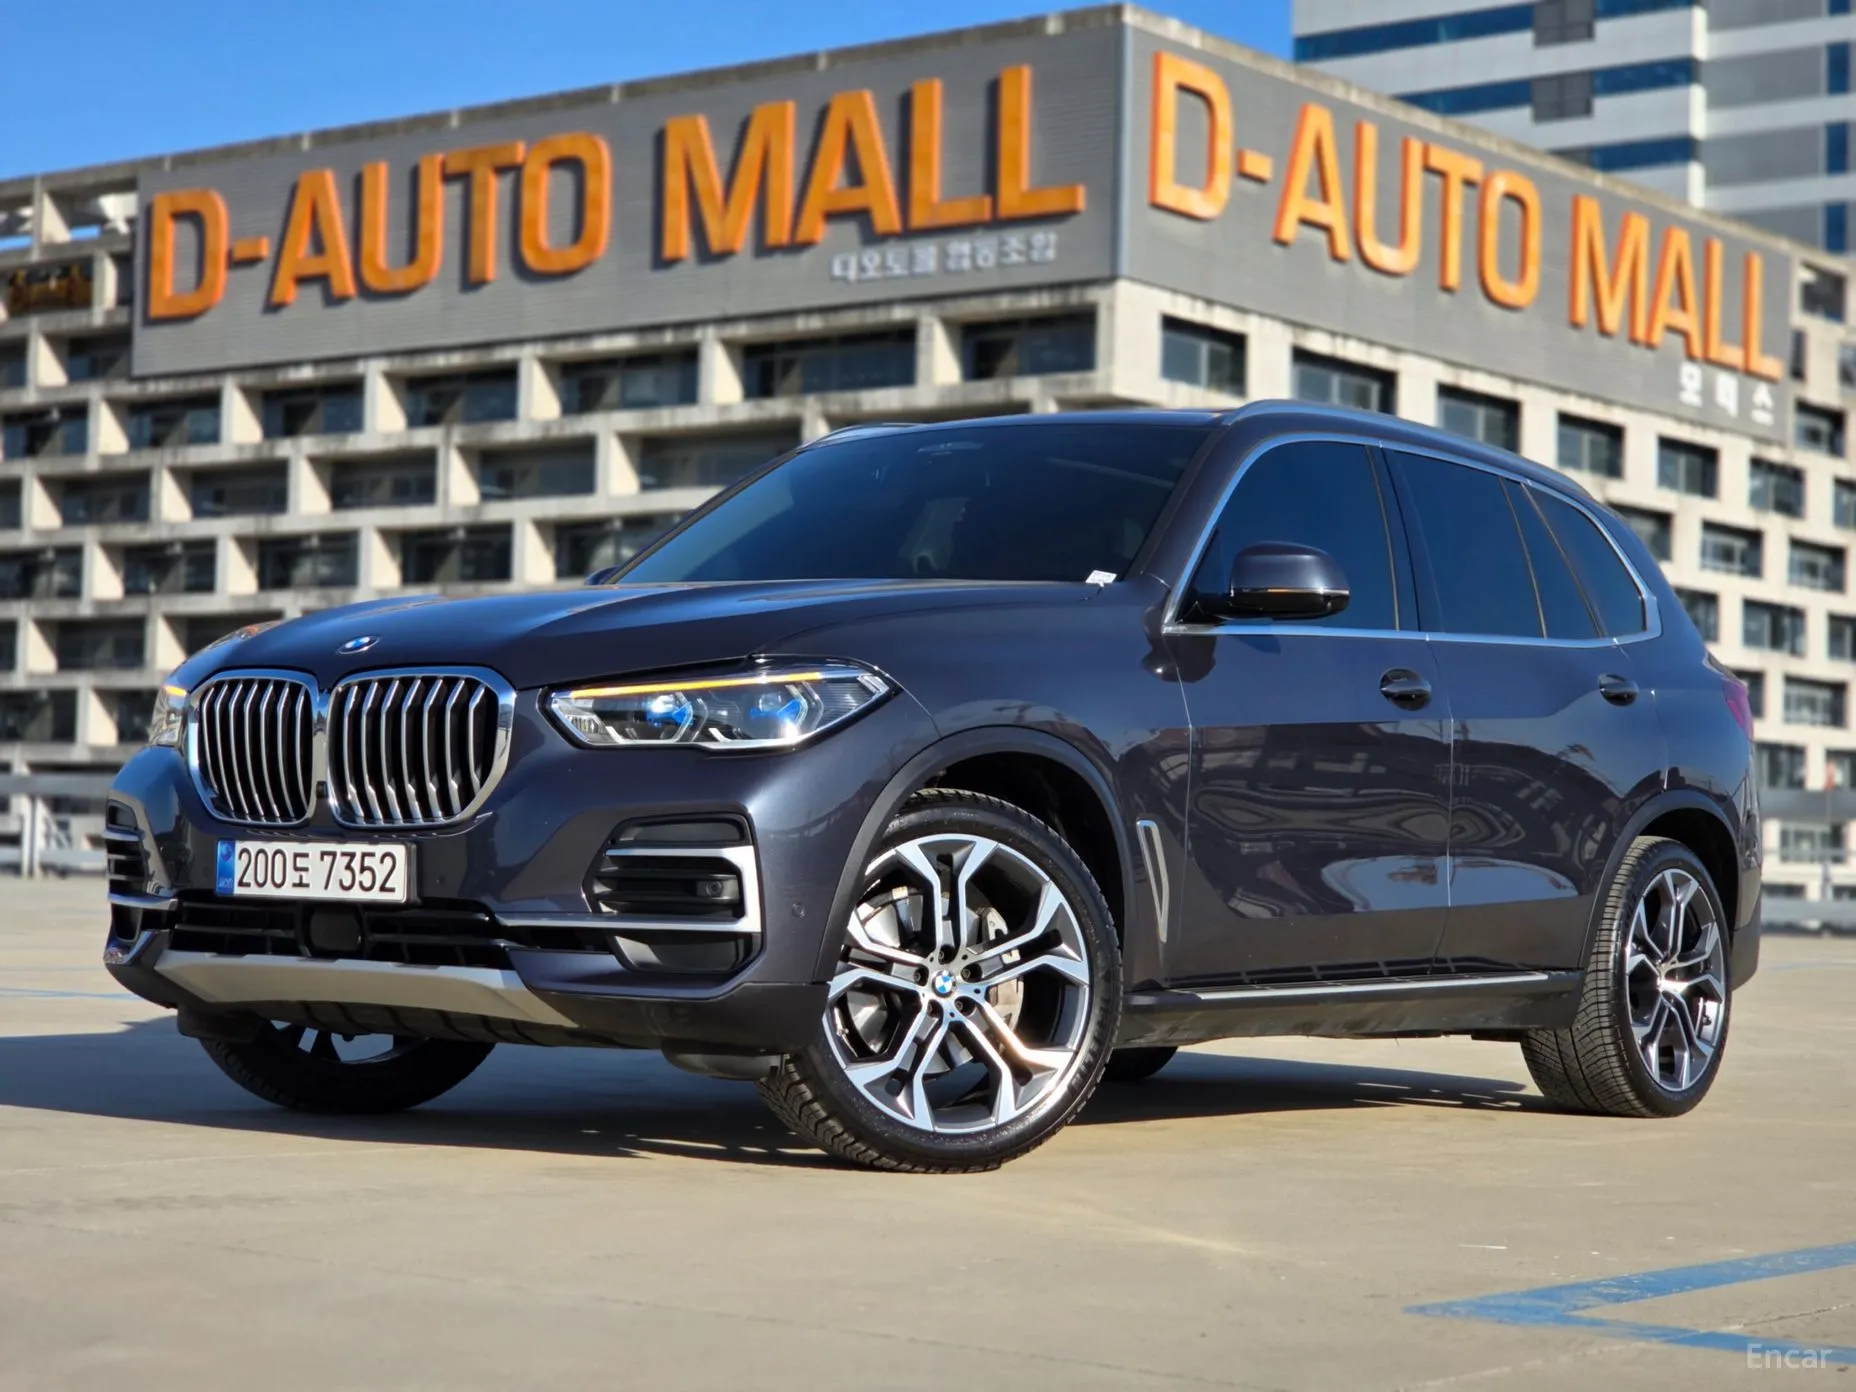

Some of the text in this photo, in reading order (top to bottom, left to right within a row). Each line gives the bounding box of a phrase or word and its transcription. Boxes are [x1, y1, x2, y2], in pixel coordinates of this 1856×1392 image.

[147, 64, 1086, 320] D-AUTO MALL
[1148, 50, 1782, 381] D-AUTO MALL
[237, 848, 397, 893] 200도 7352
